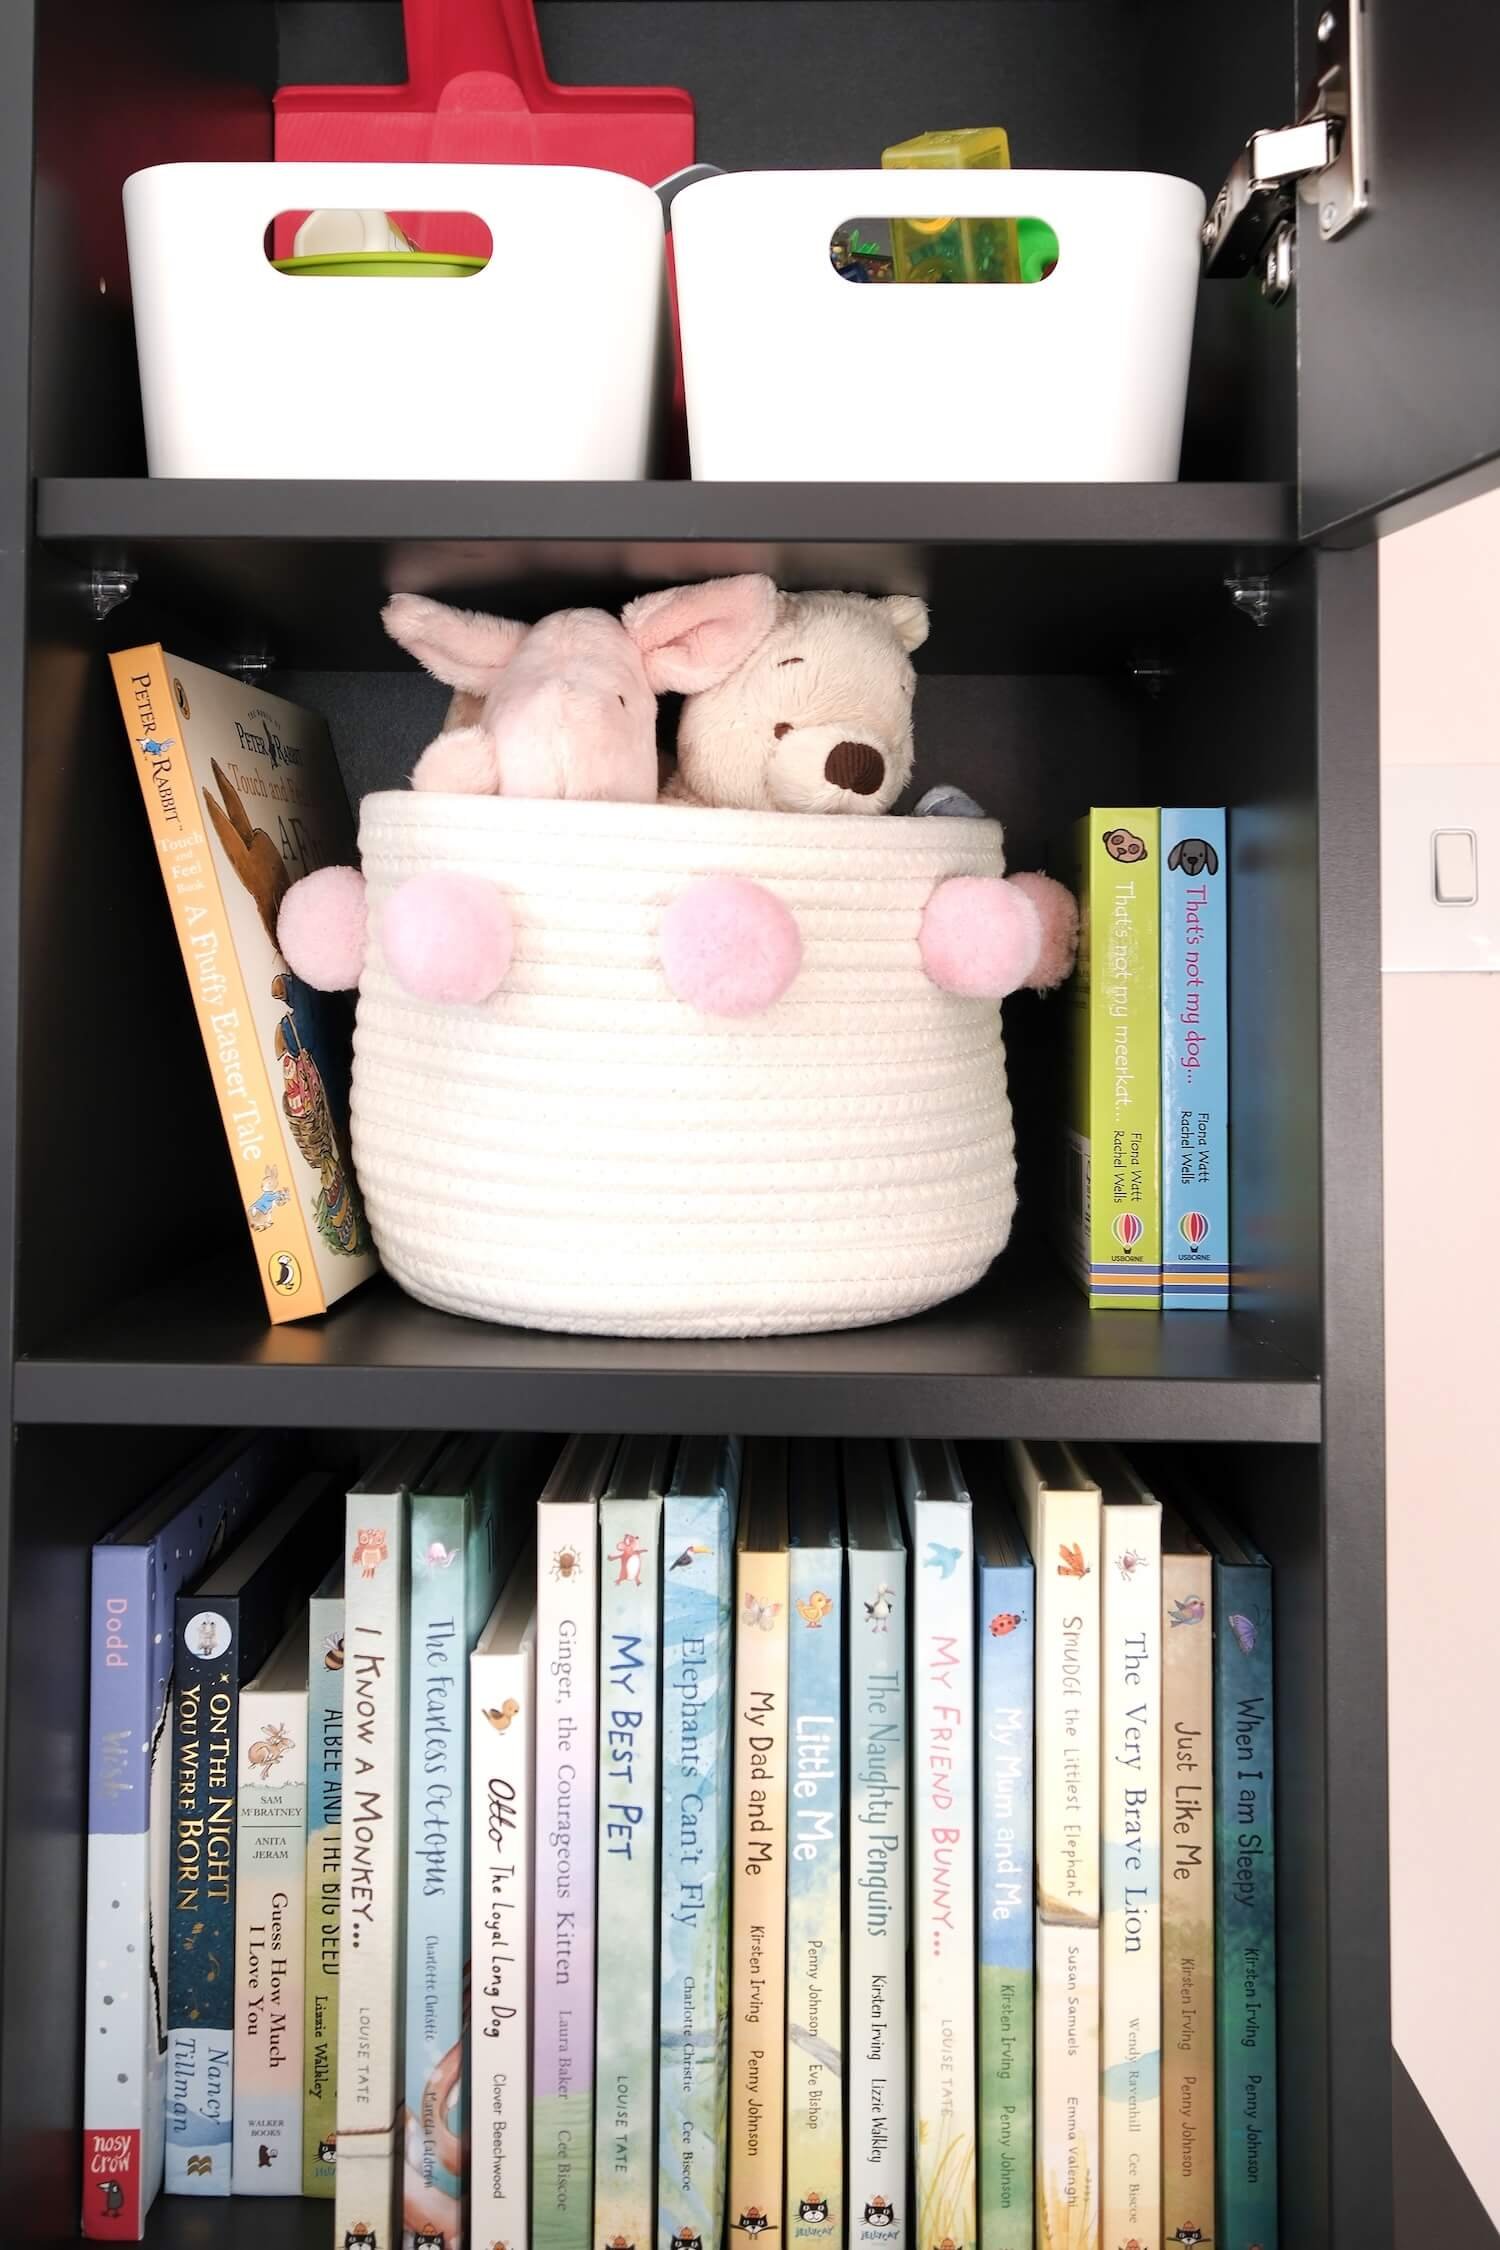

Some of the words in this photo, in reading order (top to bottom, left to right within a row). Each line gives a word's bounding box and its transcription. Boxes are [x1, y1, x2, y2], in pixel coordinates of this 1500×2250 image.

[131, 671, 157, 736] PETER
[152, 757, 178, 821] RABBIT
[228, 763, 268, 799] Touch
[160, 832, 204, 851] Touch
[185, 905, 209, 927] A
[1114, 881, 1134, 938] That's
[1185, 885, 1207, 944] That's
[190, 930, 228, 1009] Fluffy
[1115, 946, 1132, 979] not
[1186, 952, 1205, 986] not
[1109, 987, 1128, 1017] my
[1180, 993, 1199, 1024] my
[210, 1008, 246, 1098] Easter
[1180, 1030, 1206, 1084] dog...
[233, 1099, 265, 1162] Tale
[1113, 1130, 1125, 1168] Rachel
[1129, 1133, 1142, 1165] Fiona
[1181, 1111, 1192, 1149] Rachel
[1197, 1113, 1209, 1146] Fiona
[1113, 1173, 1125, 1203] Wells
[1130, 1170, 1142, 1201] Watt
[1181, 1154, 1192, 1184] Wells
[1198, 1151, 1209, 1182] Watt
[106, 1598, 128, 1667] Dodd
[355, 1628, 382, 1636] I
[426, 1617, 455, 1667] The
[550, 1620, 577, 1704] Ginger,
[609, 1635, 645, 1694] MY
[930, 1636, 960, 1689] MY
[1124, 1632, 1147, 1685] The
[179, 1685, 201, 1735] YOU
[209, 1694, 231, 1733] ON
[354, 1654, 385, 1744] KNOW
[673, 1637, 706, 1777] Elephants
[744, 1691, 775, 1726] My
[868, 1670, 899, 1714] The
[324, 1709, 343, 1771] ALBEE
[423, 1677, 454, 1774] Fearless
[558, 1717, 577, 1751] the
[991, 1707, 1022, 1746] My
[1065, 1709, 1081, 1737] the
[1116, 1703, 1147, 1771] Very
[1236, 1697, 1265, 1761] When
[209, 1738, 230, 1788] THE
[354, 1759, 378, 1774] A
[609, 1711, 642, 1784] BEST
[749, 1737, 774, 1779] Dad
[794, 1715, 835, 1798] Little
[930, 1706, 961, 1810] FRIEND
[1174, 1722, 1201, 1772] Just
[179, 1743, 200, 1809] WERE
[858, 1724, 900, 1825] Naughty
[994, 1754, 1021, 1818] Mum
[1063, 1748, 1081, 1811] Littlest
[1238, 1771, 1263, 1780] I
[260, 1796, 283, 1805] SAM
[488, 1778, 516, 1853] Otto
[749, 1790, 772, 1832] and
[1173, 1785, 1202, 1834] Like
[1239, 1790, 1258, 1824] am
[207, 1797, 235, 1904] NIGHT
[255, 1836, 286, 1846] ANITA
[416, 1784, 452, 1897] Octopus
[549, 1764, 576, 1898] Courageous
[608, 1804, 642, 1861] PET
[680, 1793, 704, 1865] Can't
[794, 1810, 834, 1861] Me
[996, 1828, 1021, 1873] and
[1124, 1788, 1147, 1871] Brave
[176, 1818, 204, 1912] BORN
[252, 1850, 289, 1860] JERAM
[745, 1841, 772, 1876] Me
[1061, 1824, 1082, 1897] Elephant
[1173, 1844, 1202, 1880] Me
[1233, 1834, 1263, 1908] Sleepy
[491, 1864, 515, 1894] The
[858, 1835, 899, 1937] Penguins
[930, 1828, 959, 1956] BUNNY...
[993, 1883, 1020, 1920] Me
[271, 1892, 288, 1951] Guess
[485, 1902, 515, 1947] Loyal
[672, 1882, 704, 1928] Fly
[1124, 1887, 1147, 1953] Lion
[248, 1942, 265, 1988] Love
[424, 1936, 438, 1992] Charlotte
[556, 1912, 575, 1985] Kitten
[749, 1926, 764, 1974] Kirsten
[806, 1940, 822, 1979] Penny
[1068, 1946, 1079, 1990] Susan
[270, 1959, 287, 2006] How
[484, 1956, 515, 1997] Long
[1181, 1958, 1194, 2004] Kirsten
[1244, 1948, 1259, 1997] Kirsten
[248, 1999, 263, 2035] You
[315, 1995, 327, 2037] Lizzie
[424, 1995, 438, 2041] Christie
[683, 1976, 695, 2036] Charlotte
[746, 1979, 764, 2023] Irving
[807, 1984, 821, 2037] Johnson
[871, 1975, 886, 2018] Kirsten
[1001, 1985, 1015, 2031] Kirsten
[269, 2013, 286, 2068] Much
[357, 2007, 369, 2058] LOUISE
[484, 2007, 516, 2038] Dog
[558, 2010, 572, 2053] Laura
[867, 2023, 886, 2060] Irving
[941, 2019, 953, 2071] LOUISE
[1068, 1997, 1079, 2056] Samuels
[1125, 2018, 1140, 2063] Wendy
[1178, 2009, 1195, 2051] Irving
[1241, 2002, 1261, 2047] Irving
[309, 2043, 328, 2100] Walkley
[558, 2058, 572, 2100] Baker
[682, 2043, 695, 2092] Christie
[746, 2051, 763, 2092] Penny
[808, 2064, 821, 2086] Eve
[997, 2037, 1016, 2079] Irving
[173, 2038, 196, 2133] Tillman
[199, 2048, 229, 2126] Nancy
[356, 2067, 369, 2104] TATE
[493, 2074, 506, 2116] Clover
[615, 2076, 628, 2127] LOUISE
[871, 2079, 886, 2113] Lizzie
[940, 2079, 952, 2117] TATE
[1128, 2071, 1140, 2132] Ravenhill
[1180, 2076, 1195, 2117] Penny
[1244, 2075, 1261, 2118] Penny
[248, 2119, 285, 2127] WALKER
[250, 2129, 281, 2137] BOOKS
[682, 2121, 694, 2144] Cee
[747, 2099, 762, 2157] Johnson
[805, 2091, 821, 2130] Bishop
[998, 2105, 1015, 2147] Penny
[1067, 2097, 1078, 2140] Emma
[93, 2135, 131, 2159] nosy
[492, 2121, 506, 2199] Beechwood
[557, 2130, 572, 2159] Cee
[615, 2135, 628, 2173] TATE
[867, 2117, 887, 2163] Walkley
[1181, 2122, 1195, 2177] Johnson
[1246, 2124, 1261, 2184] Johnson
[557, 2163, 571, 2211] Biscoe
[682, 2151, 693, 2192] Biscoe
[1000, 2152, 1015, 2208] Johnson
[1064, 2147, 1078, 2208] Valenghi
[1128, 2153, 1139, 2176] Cee
[1128, 2184, 1139, 2223] Biscoe
